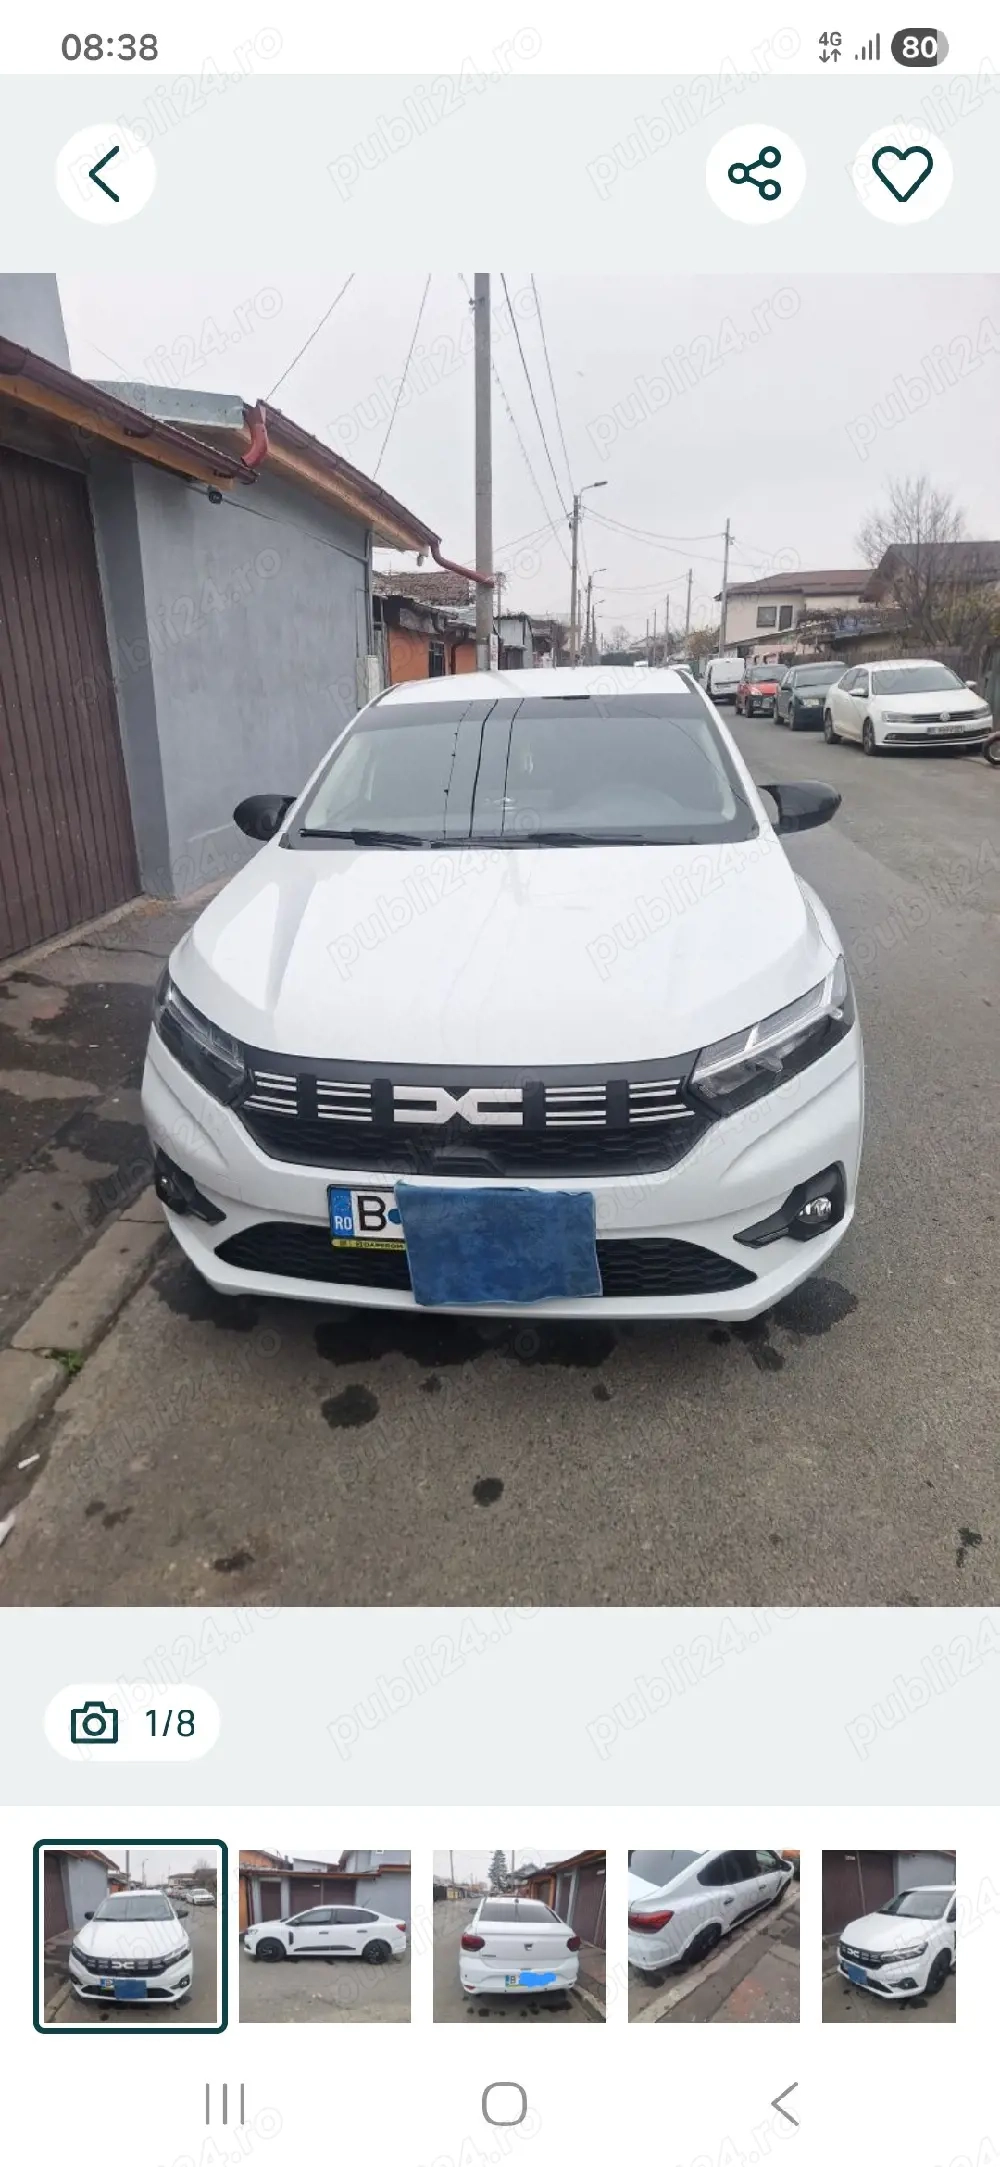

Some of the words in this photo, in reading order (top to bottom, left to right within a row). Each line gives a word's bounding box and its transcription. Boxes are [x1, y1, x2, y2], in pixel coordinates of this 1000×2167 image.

[62, 33, 158, 61] 08:38
[819, 31, 842, 46] 4G
[902, 36, 938, 58] 80
[334, 1214, 353, 1230] RO
[357, 1195, 387, 1231] B
[145, 1709, 195, 1737] 1/8
